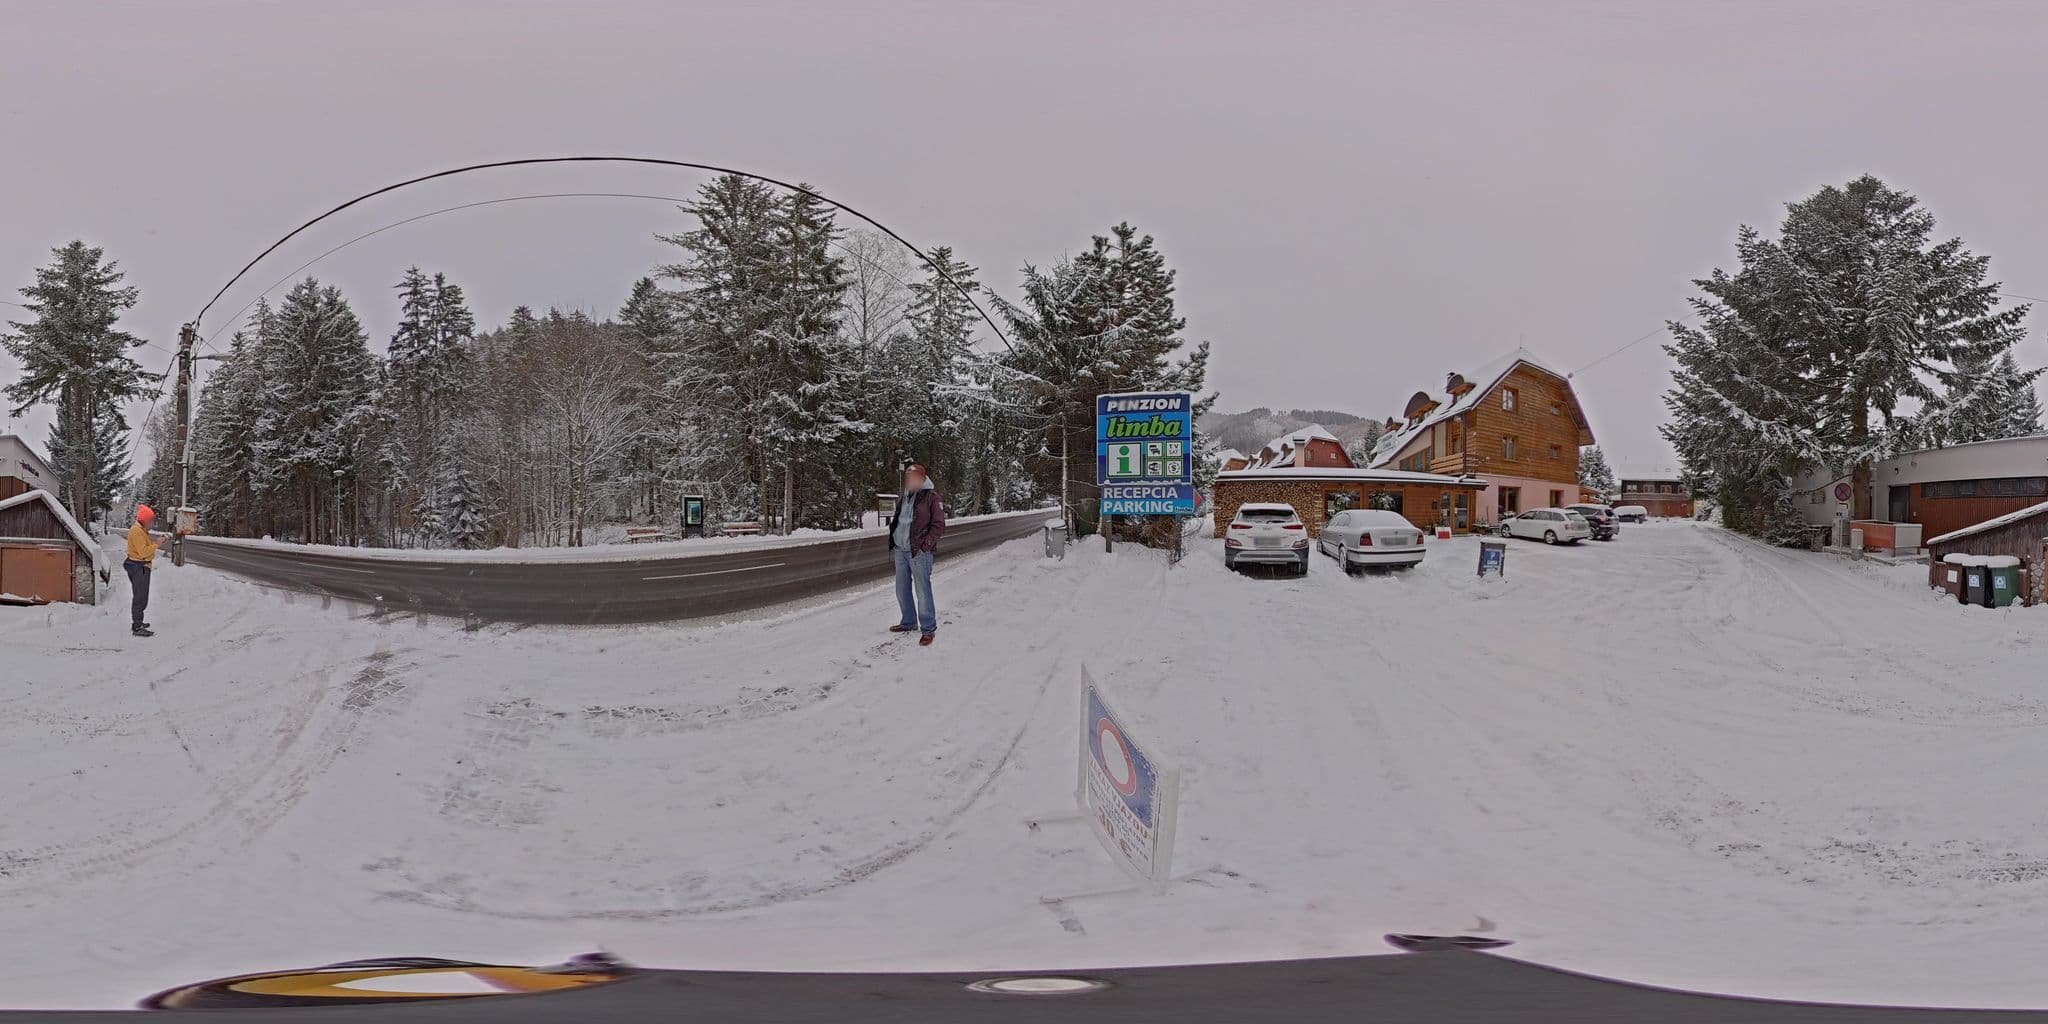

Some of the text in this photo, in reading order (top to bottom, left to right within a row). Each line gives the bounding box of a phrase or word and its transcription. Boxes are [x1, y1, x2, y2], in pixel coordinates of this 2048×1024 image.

[1107, 399, 1181, 412] PENZION
[1106, 415, 1182, 438] limba
[1103, 487, 1179, 499] RECEPCIA
[1103, 500, 1174, 513] PARKING
